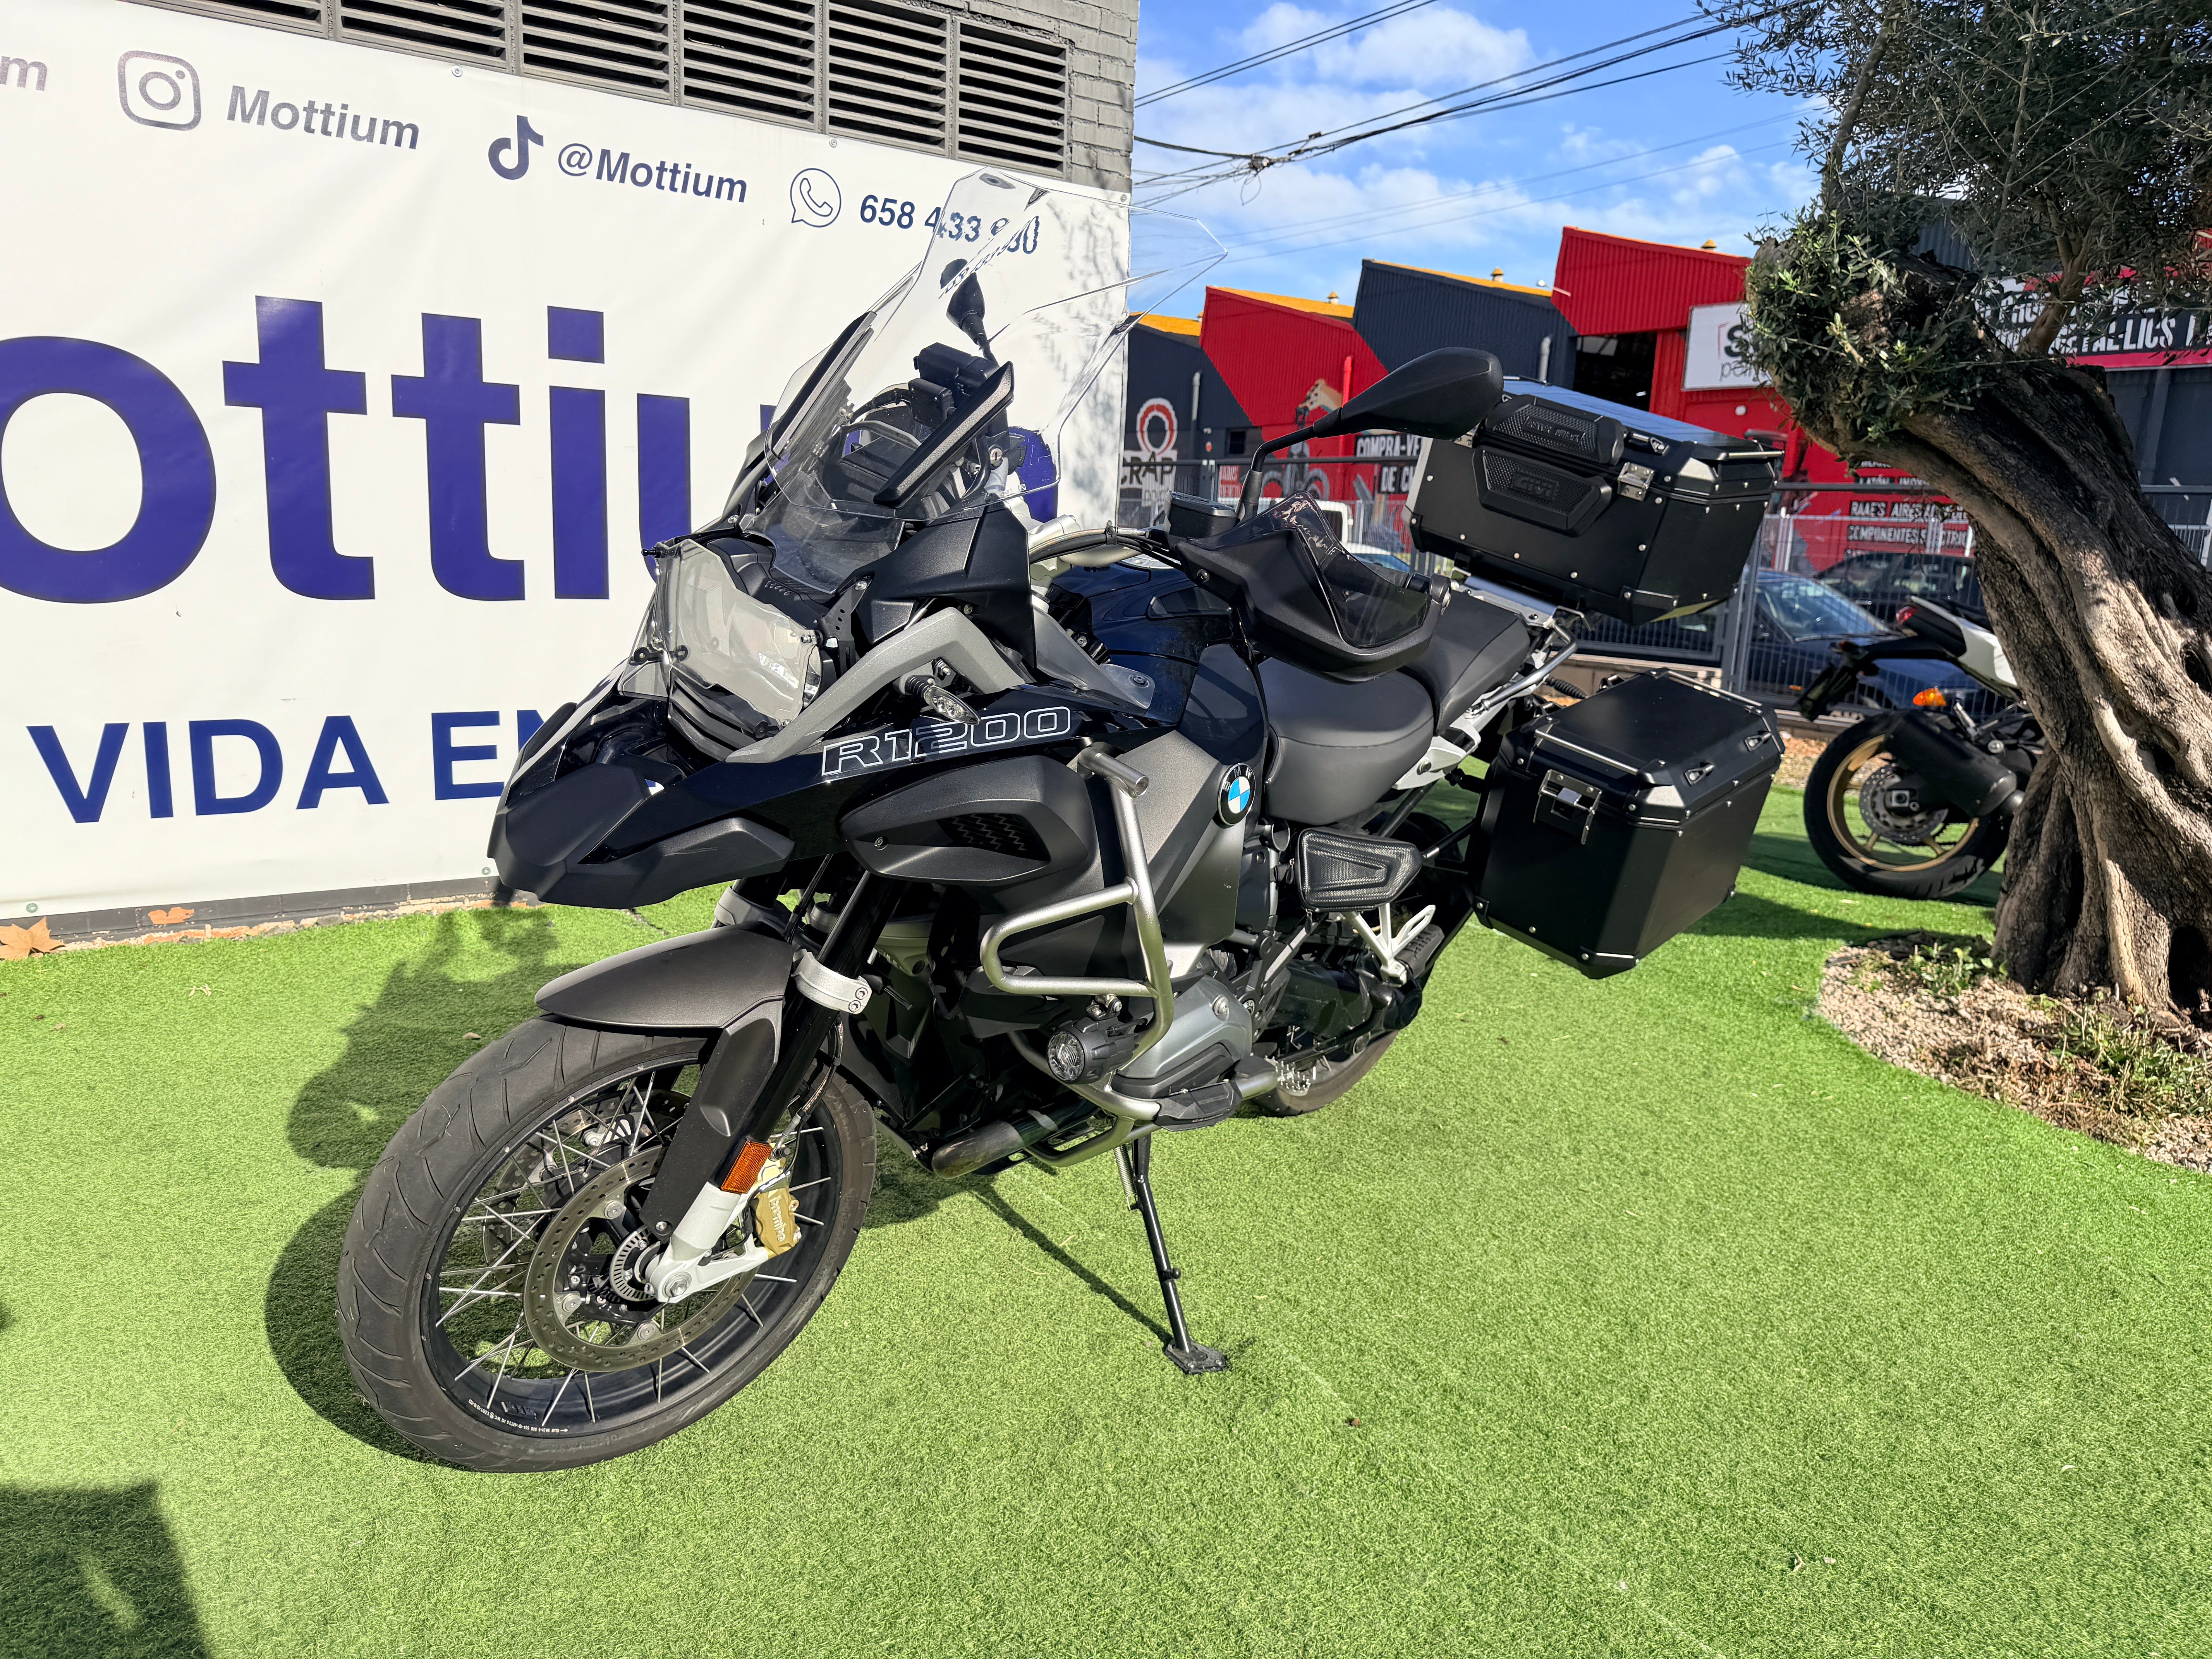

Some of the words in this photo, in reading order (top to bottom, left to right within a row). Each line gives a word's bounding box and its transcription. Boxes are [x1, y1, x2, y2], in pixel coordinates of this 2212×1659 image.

[227, 85, 419, 149] Mottium
[558, 143, 747, 203] @Mottium
[860, 194, 915, 229] 658
[1121, 452, 1174, 486] RAP
[821, 706, 1071, 777] R1200
[26, 715, 389, 823] VIDA
[1223, 766, 1252, 793] BMW
[769, 1197, 786, 1242] brembo
